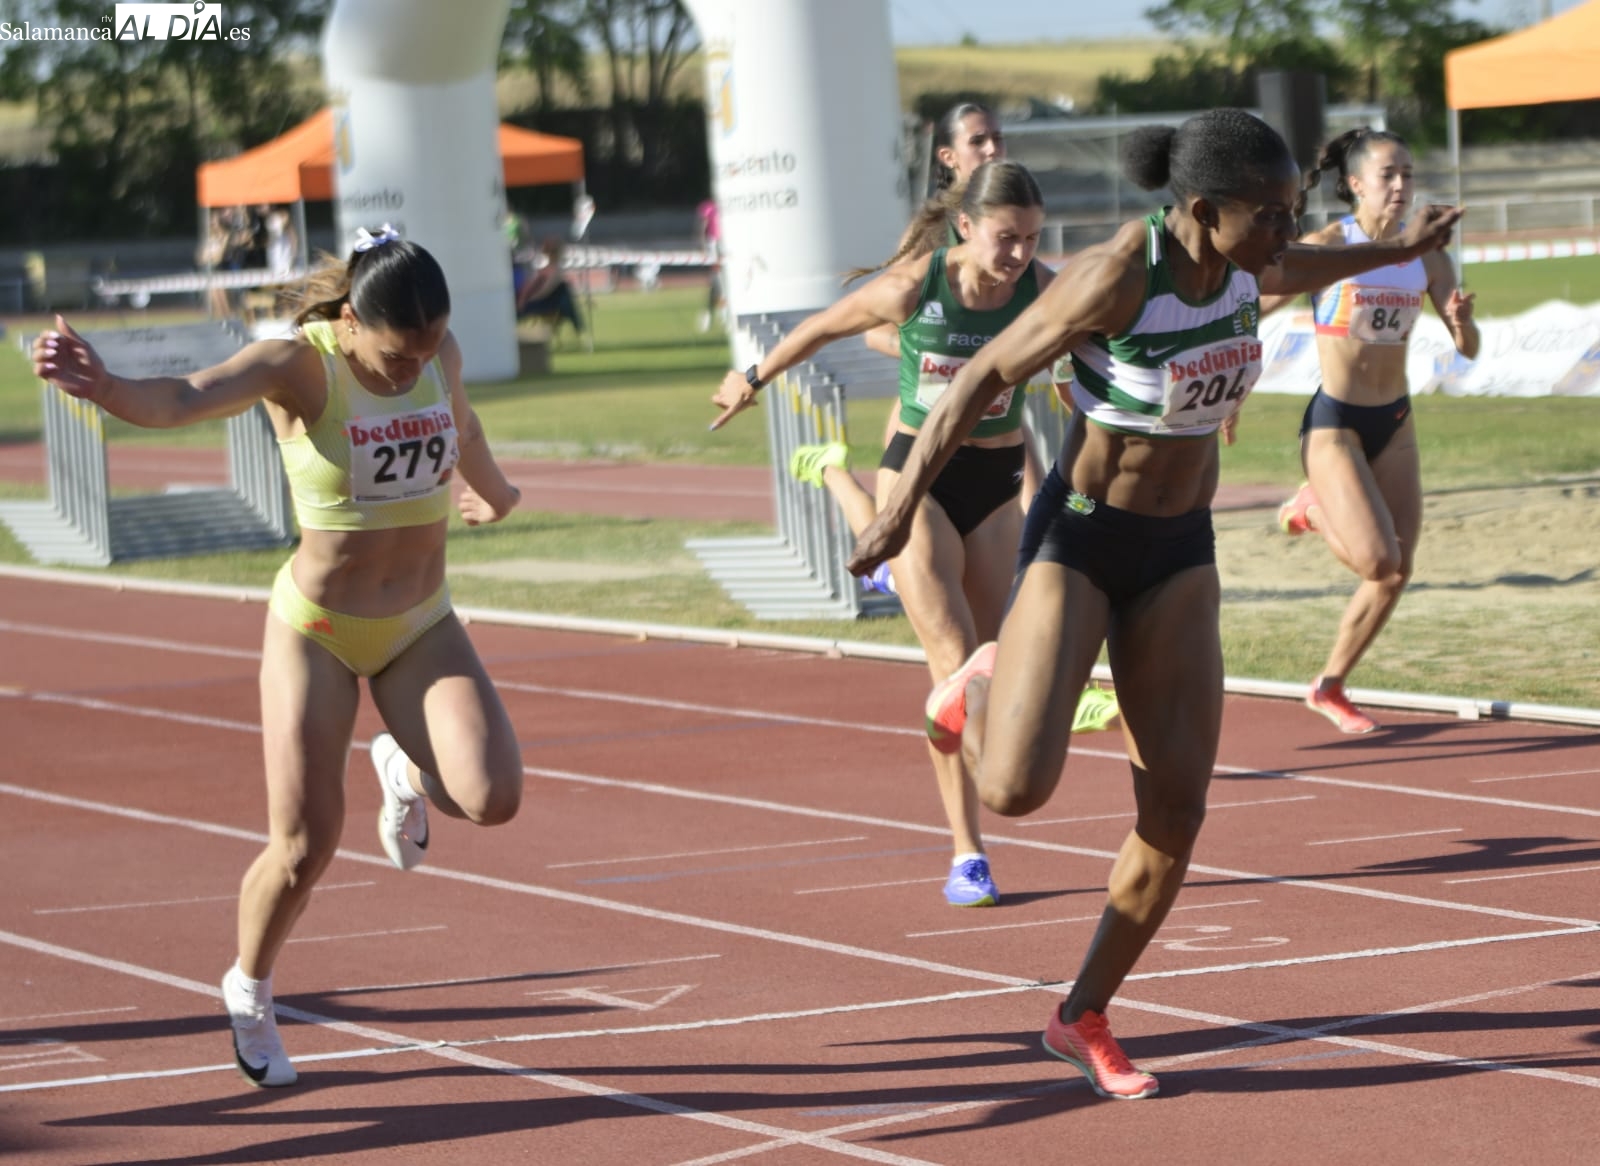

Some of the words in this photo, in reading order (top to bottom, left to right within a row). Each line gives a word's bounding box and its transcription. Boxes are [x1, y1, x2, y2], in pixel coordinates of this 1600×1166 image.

[717, 148, 797, 179] miento
[1355, 293, 1420, 307] bedunia
[1371, 307, 1402, 331] 84
[1169, 342, 1263, 384] bedunia
[1177, 366, 1246, 413] 204
[350, 411, 453, 448] bedunia
[373, 435, 446, 485] 279
